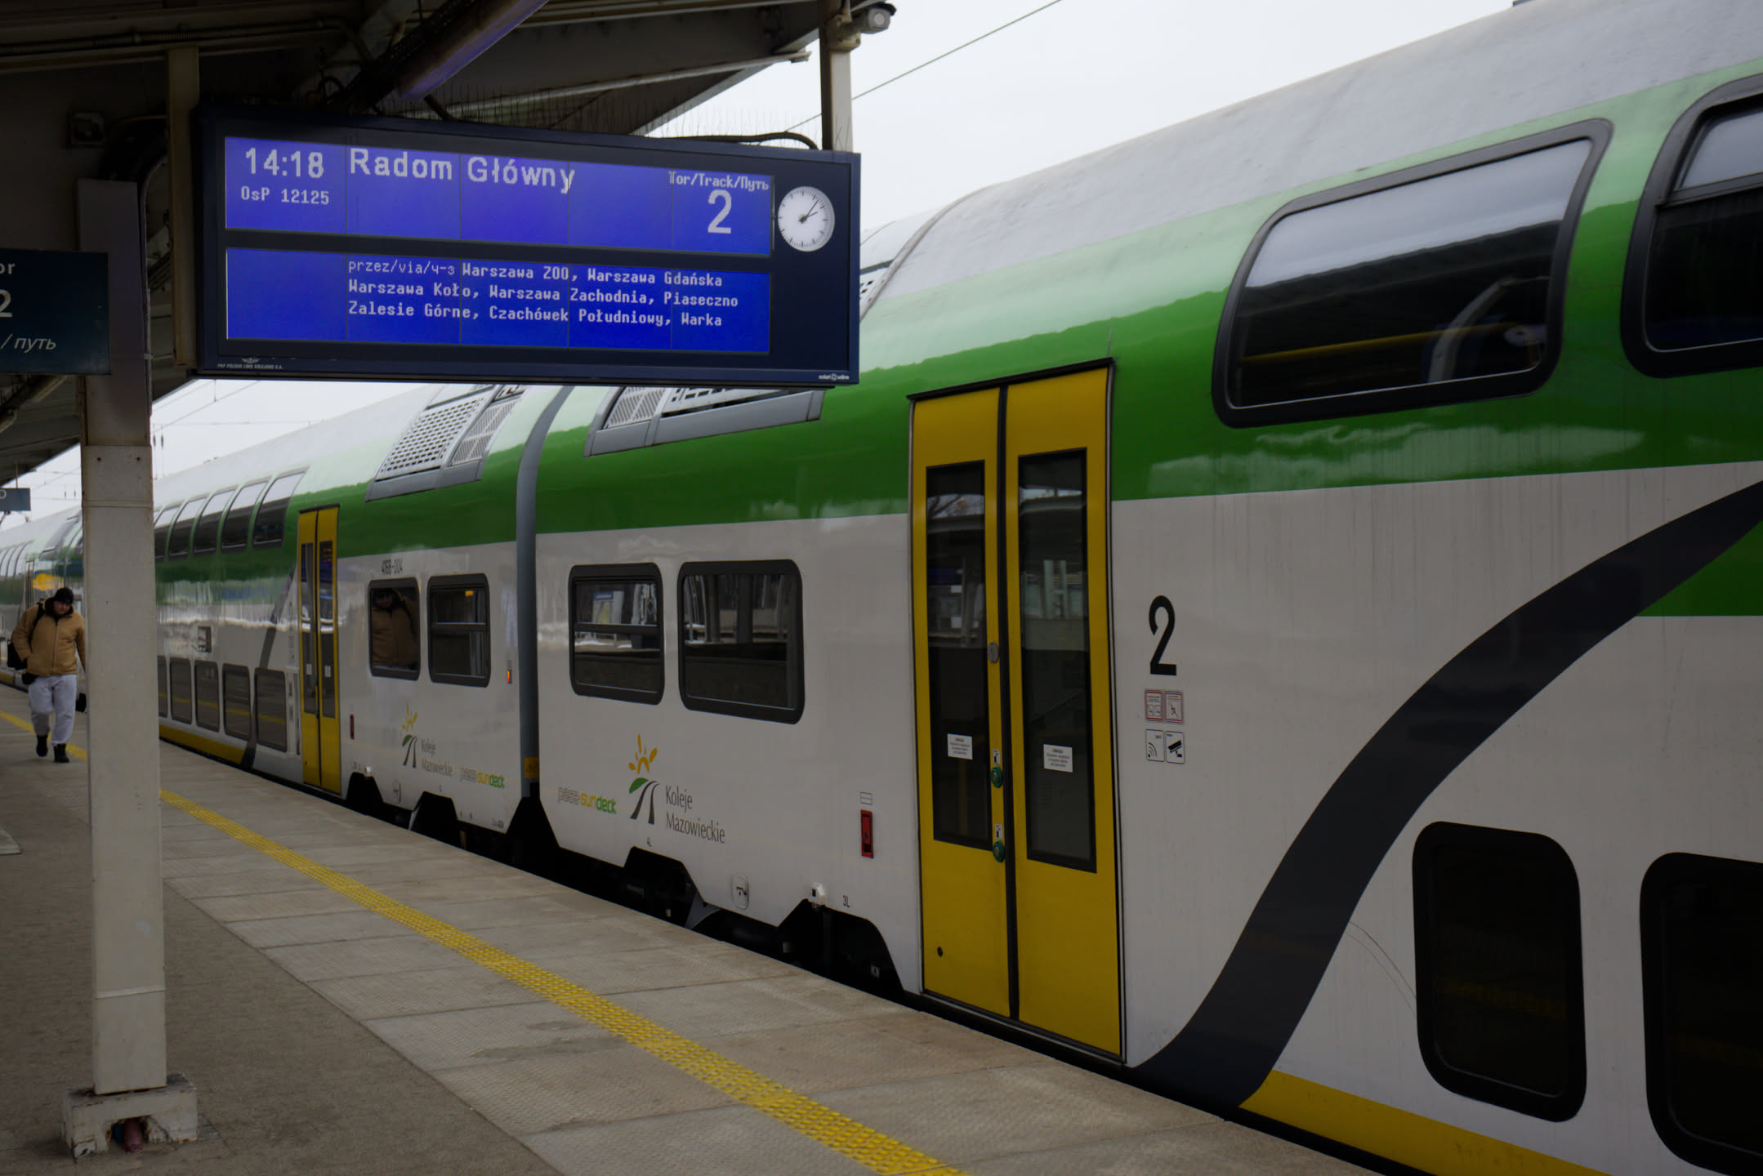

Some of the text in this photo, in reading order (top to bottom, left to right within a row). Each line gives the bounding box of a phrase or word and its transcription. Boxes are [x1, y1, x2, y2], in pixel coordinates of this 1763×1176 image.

[245, 148, 324, 179] 14:18
[350, 147, 576, 195] Radom Główny
[241, 186, 330, 205] OsP 12125
[707, 189, 733, 235] 2
[462, 262, 534, 279] Warszawa
[587, 268, 656, 284] Warszawa
[664, 271, 723, 287] Gdańska
[348, 279, 739, 307] Warszawa Koło, Warszawa Zachodnia, Piaseczno
[348, 300, 722, 327] Zalesie Górne, Czachówek Południowy, Warka
[1148, 594, 1177, 676] 2
[665, 784, 693, 813] Koleje
[666, 811, 726, 844] Mazowieckie
